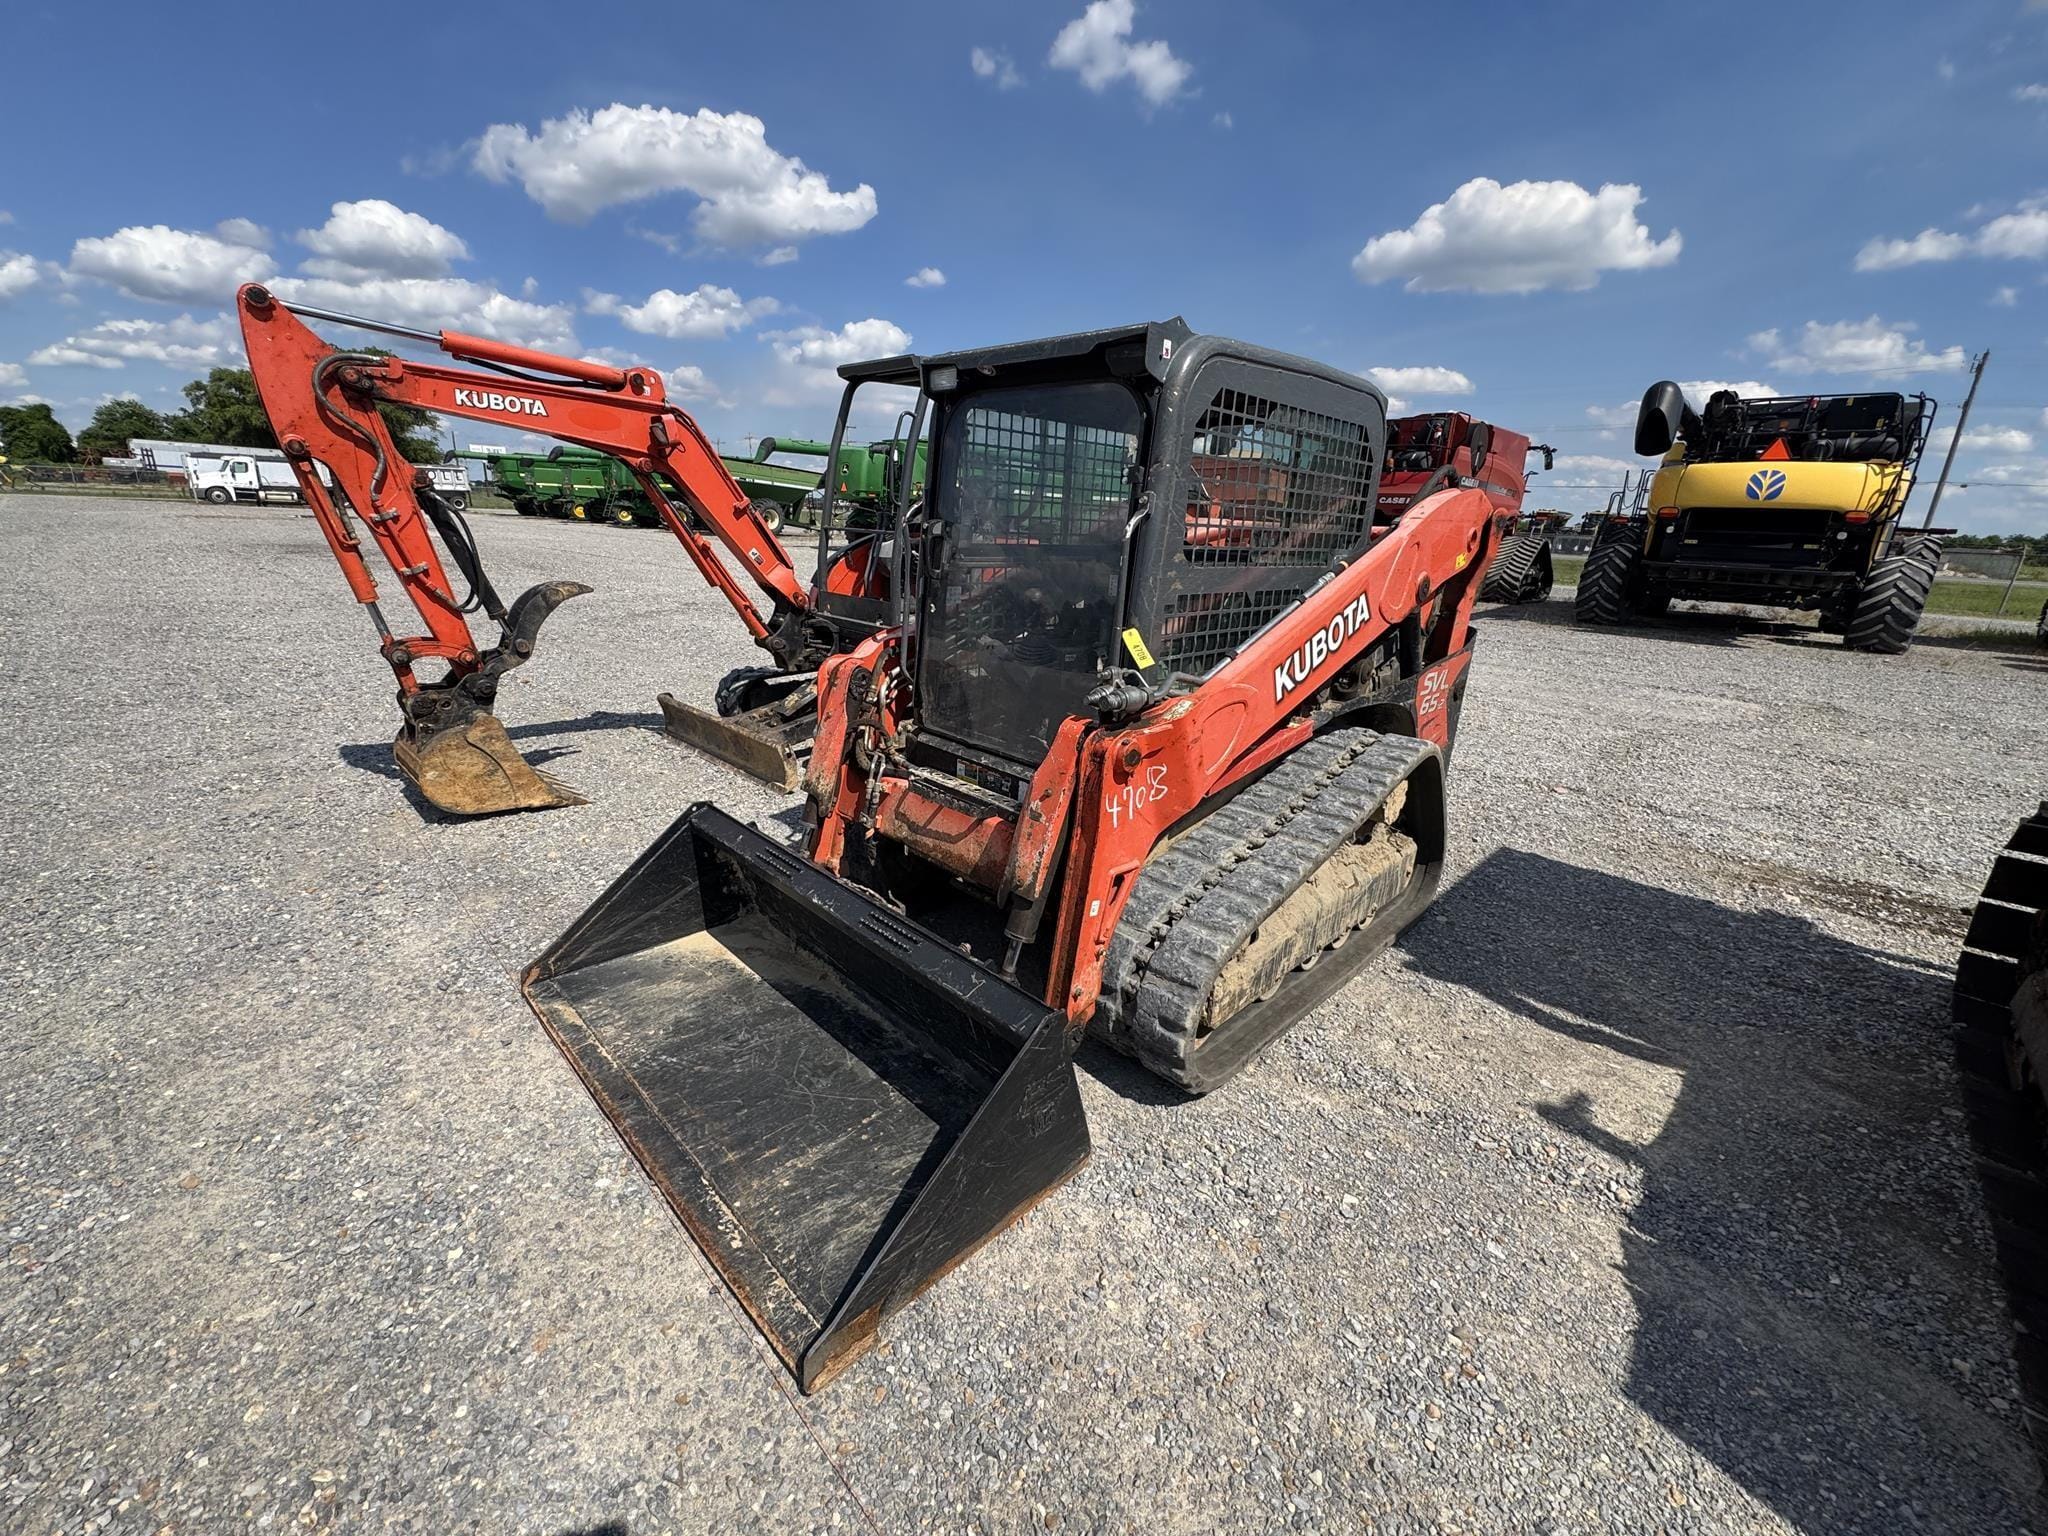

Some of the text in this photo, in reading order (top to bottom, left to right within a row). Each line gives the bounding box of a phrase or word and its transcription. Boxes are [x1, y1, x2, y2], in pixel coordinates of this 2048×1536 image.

[454, 388, 549, 417] KUBOTA
[1379, 496, 1405, 504] CASE
[1133, 643, 1148, 661] 4708
[1274, 592, 1370, 703] KUBOTA
[1420, 669, 1449, 696] SVL
[1105, 763, 1168, 828] 4708
